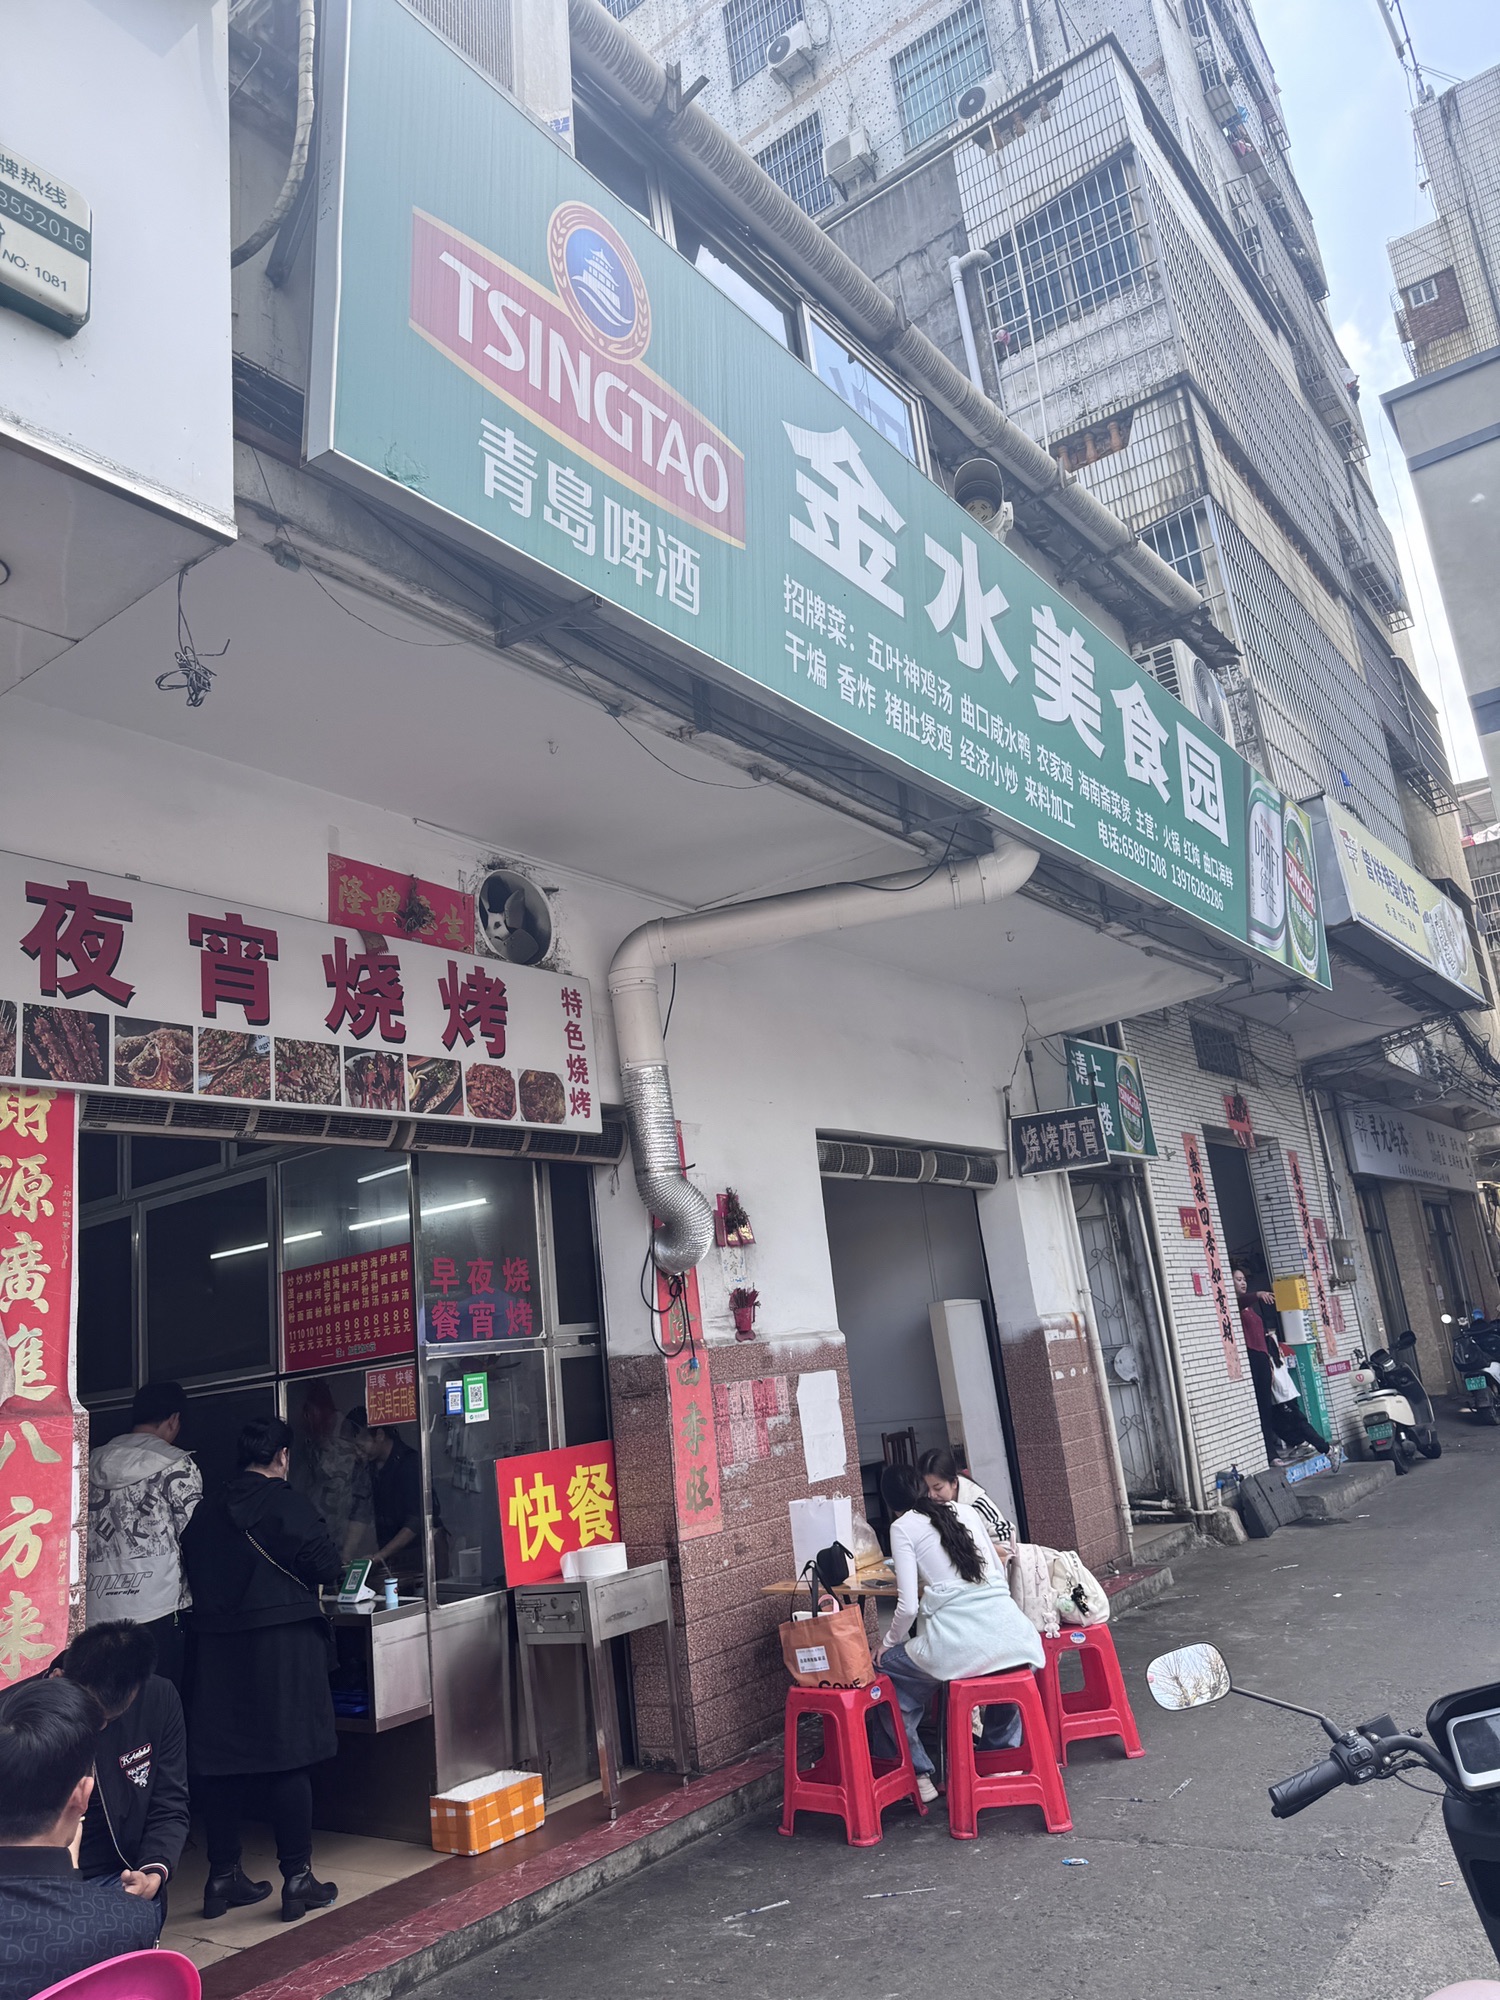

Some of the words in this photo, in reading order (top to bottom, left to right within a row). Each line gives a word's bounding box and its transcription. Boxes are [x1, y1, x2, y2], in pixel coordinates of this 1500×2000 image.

[35, 266, 67, 292] 1081
[438, 250, 728, 513] TSINGTAO
[781, 420, 1230, 848] 金水美食园
[784, 629, 828, 690] 干煸
[837, 662, 876, 715] 香炸
[884, 689, 953, 760] 猪肚煲鸡
[960, 735, 1018, 794] 经济小炒
[1024, 775, 1075, 829] 来料加工
[867, 631, 953, 715] 五叶神鸡汤
[960, 693, 1031, 765] 曲口咸水鸭
[1036, 744, 1074, 791] 农家鸡
[1078, 769, 1132, 826] 海南斋菜煲
[1162, 824, 1181, 857] 火锅
[1203, 850, 1234, 891] 曲口海鲜
[1171, 863, 1224, 912] 13976283286
[18, 880, 509, 1060] 夜宵烧烤
[560, 986, 592, 1120] 特色烧烤
[1020, 1115, 1101, 1165] 烧烤夜宵
[466, 1256, 500, 1340] 夜宵
[502, 1255, 534, 1337] 烧烤
[508, 1462, 614, 1563] 快餐
